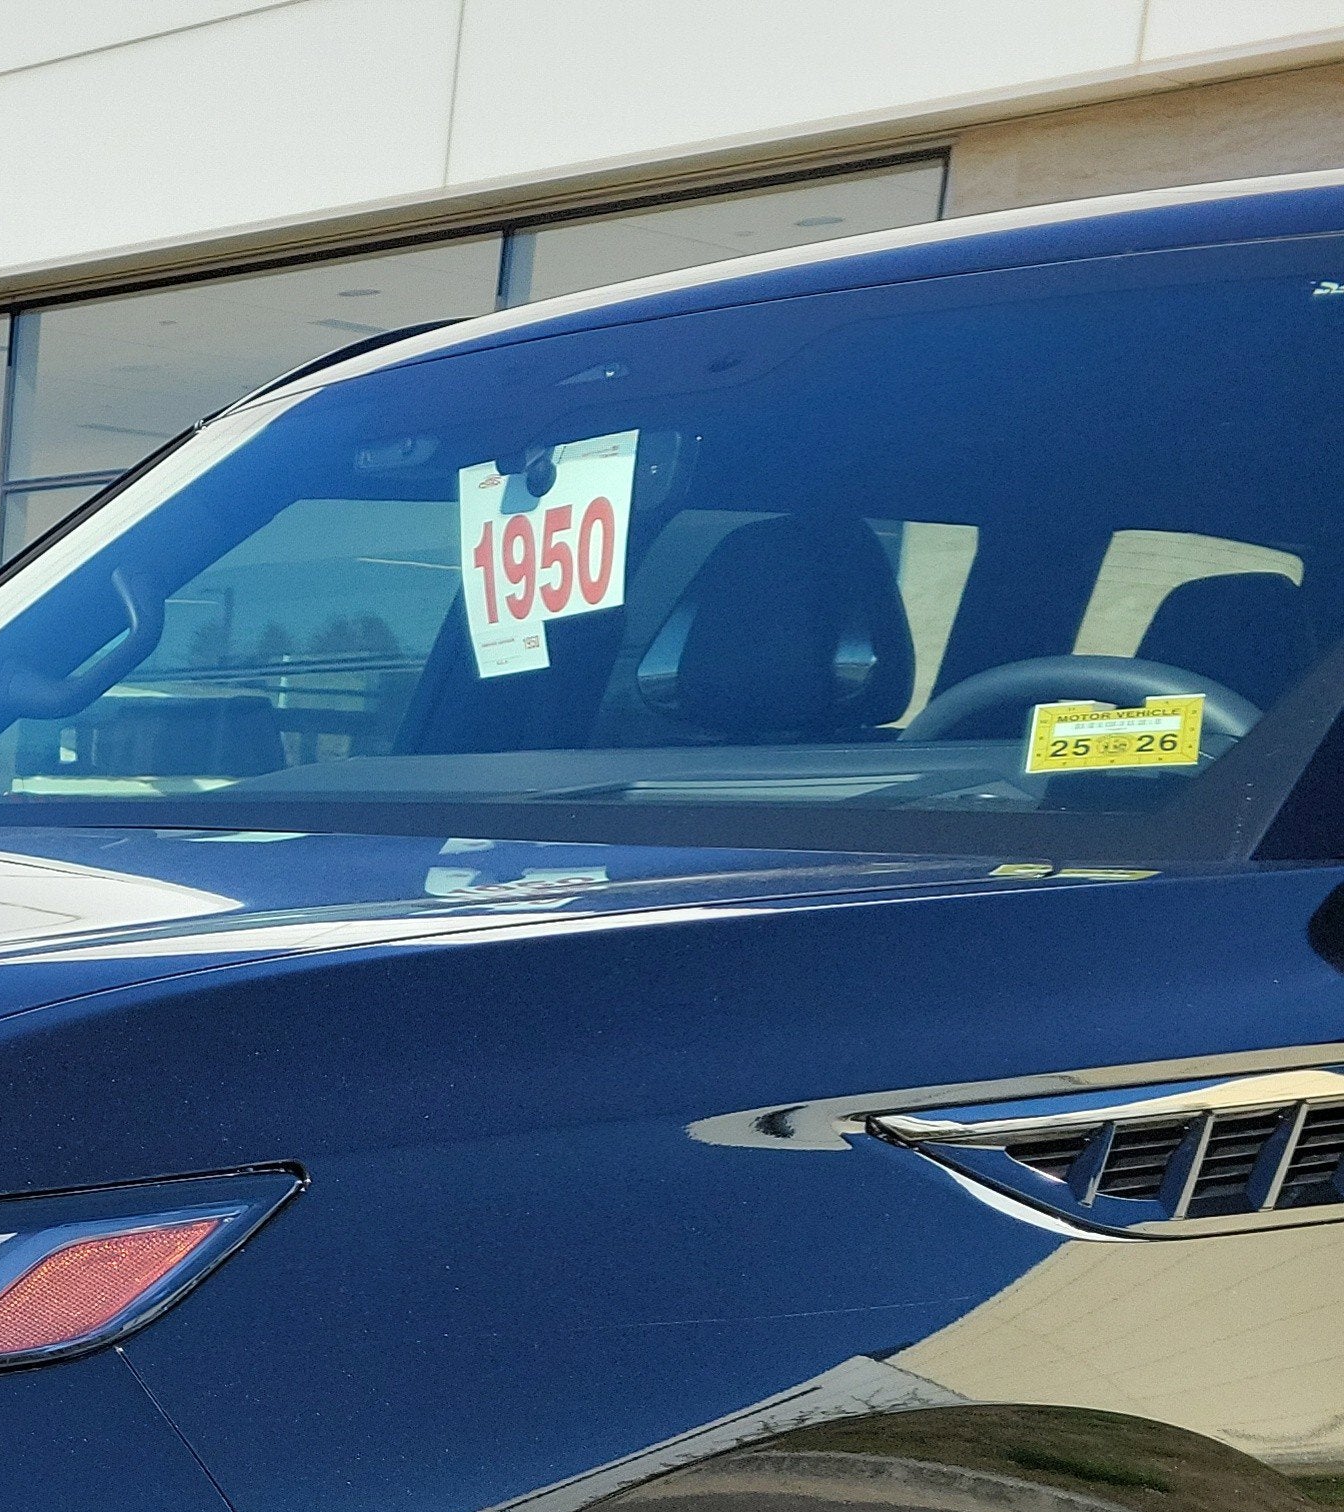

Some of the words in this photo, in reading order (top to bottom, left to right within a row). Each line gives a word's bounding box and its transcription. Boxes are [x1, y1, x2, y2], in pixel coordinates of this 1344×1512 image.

[473, 496, 615, 625] 1950
[1056, 711, 1111, 722] MOTOR
[1116, 707, 1181, 718] VEHICLE
[1049, 738, 1091, 757] 25
[1135, 733, 1179, 753] 26
